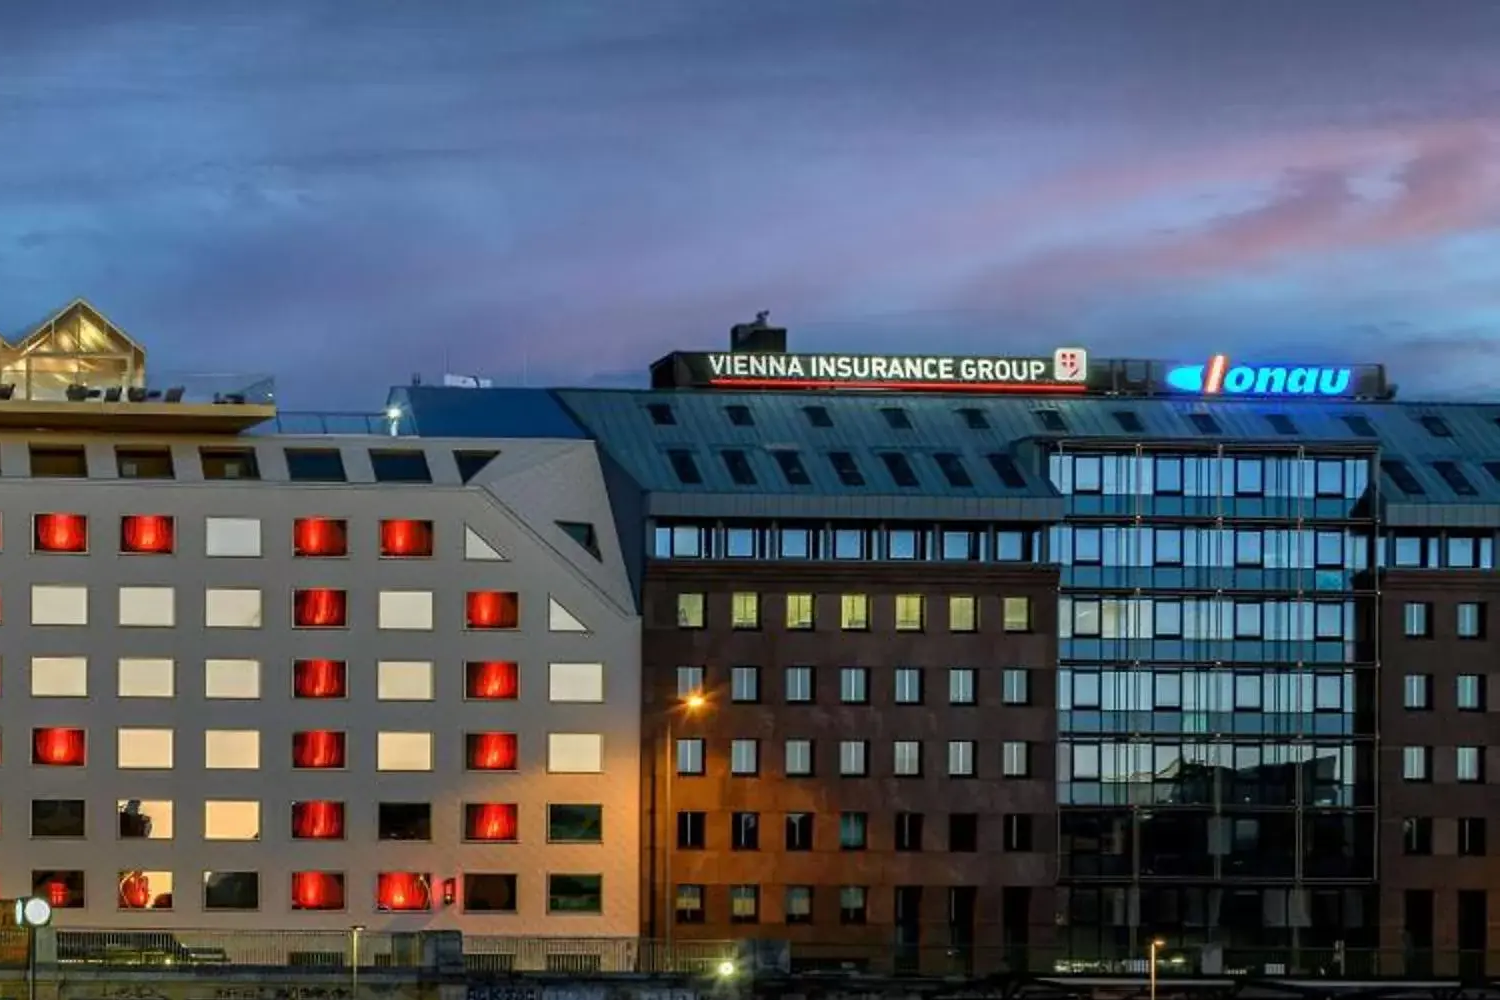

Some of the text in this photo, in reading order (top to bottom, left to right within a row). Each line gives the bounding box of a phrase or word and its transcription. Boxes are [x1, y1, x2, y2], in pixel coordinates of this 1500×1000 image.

[709, 354, 1046, 380] VIENNA INSURANCE GROUP
